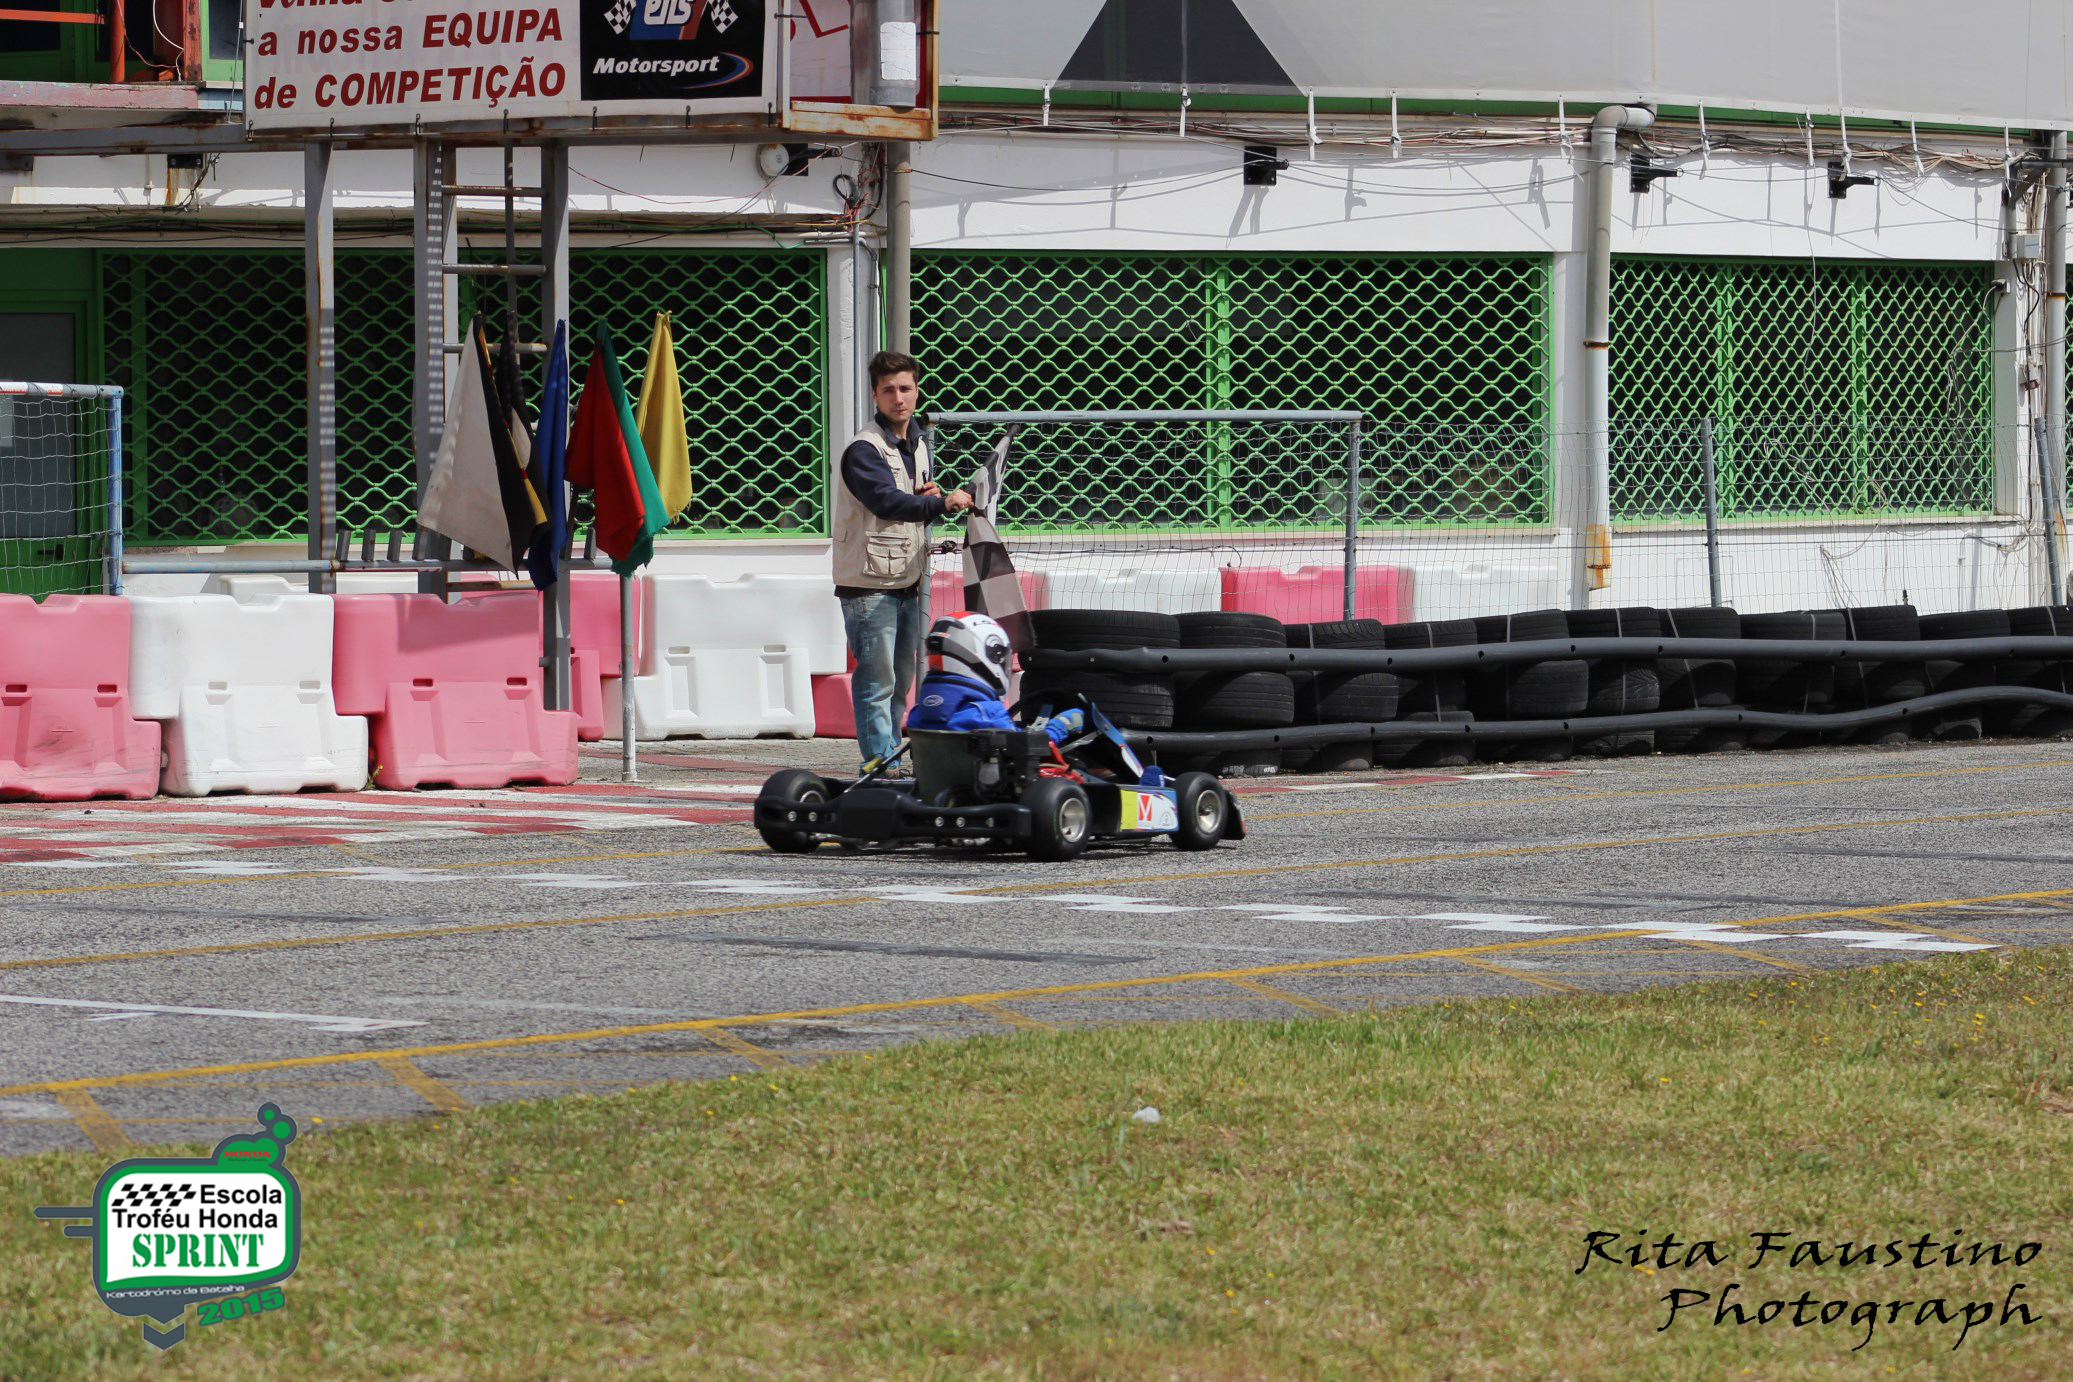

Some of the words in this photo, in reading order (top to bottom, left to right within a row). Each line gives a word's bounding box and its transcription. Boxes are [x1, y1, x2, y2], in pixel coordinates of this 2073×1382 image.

[258, 31, 277, 56] a
[298, 25, 403, 55] nossa
[422, 8, 563, 49] EQUIPA
[255, 77, 297, 109] de
[315, 56, 566, 108] COMPETIÇÃO
[592, 56, 720, 77] Motorsport
